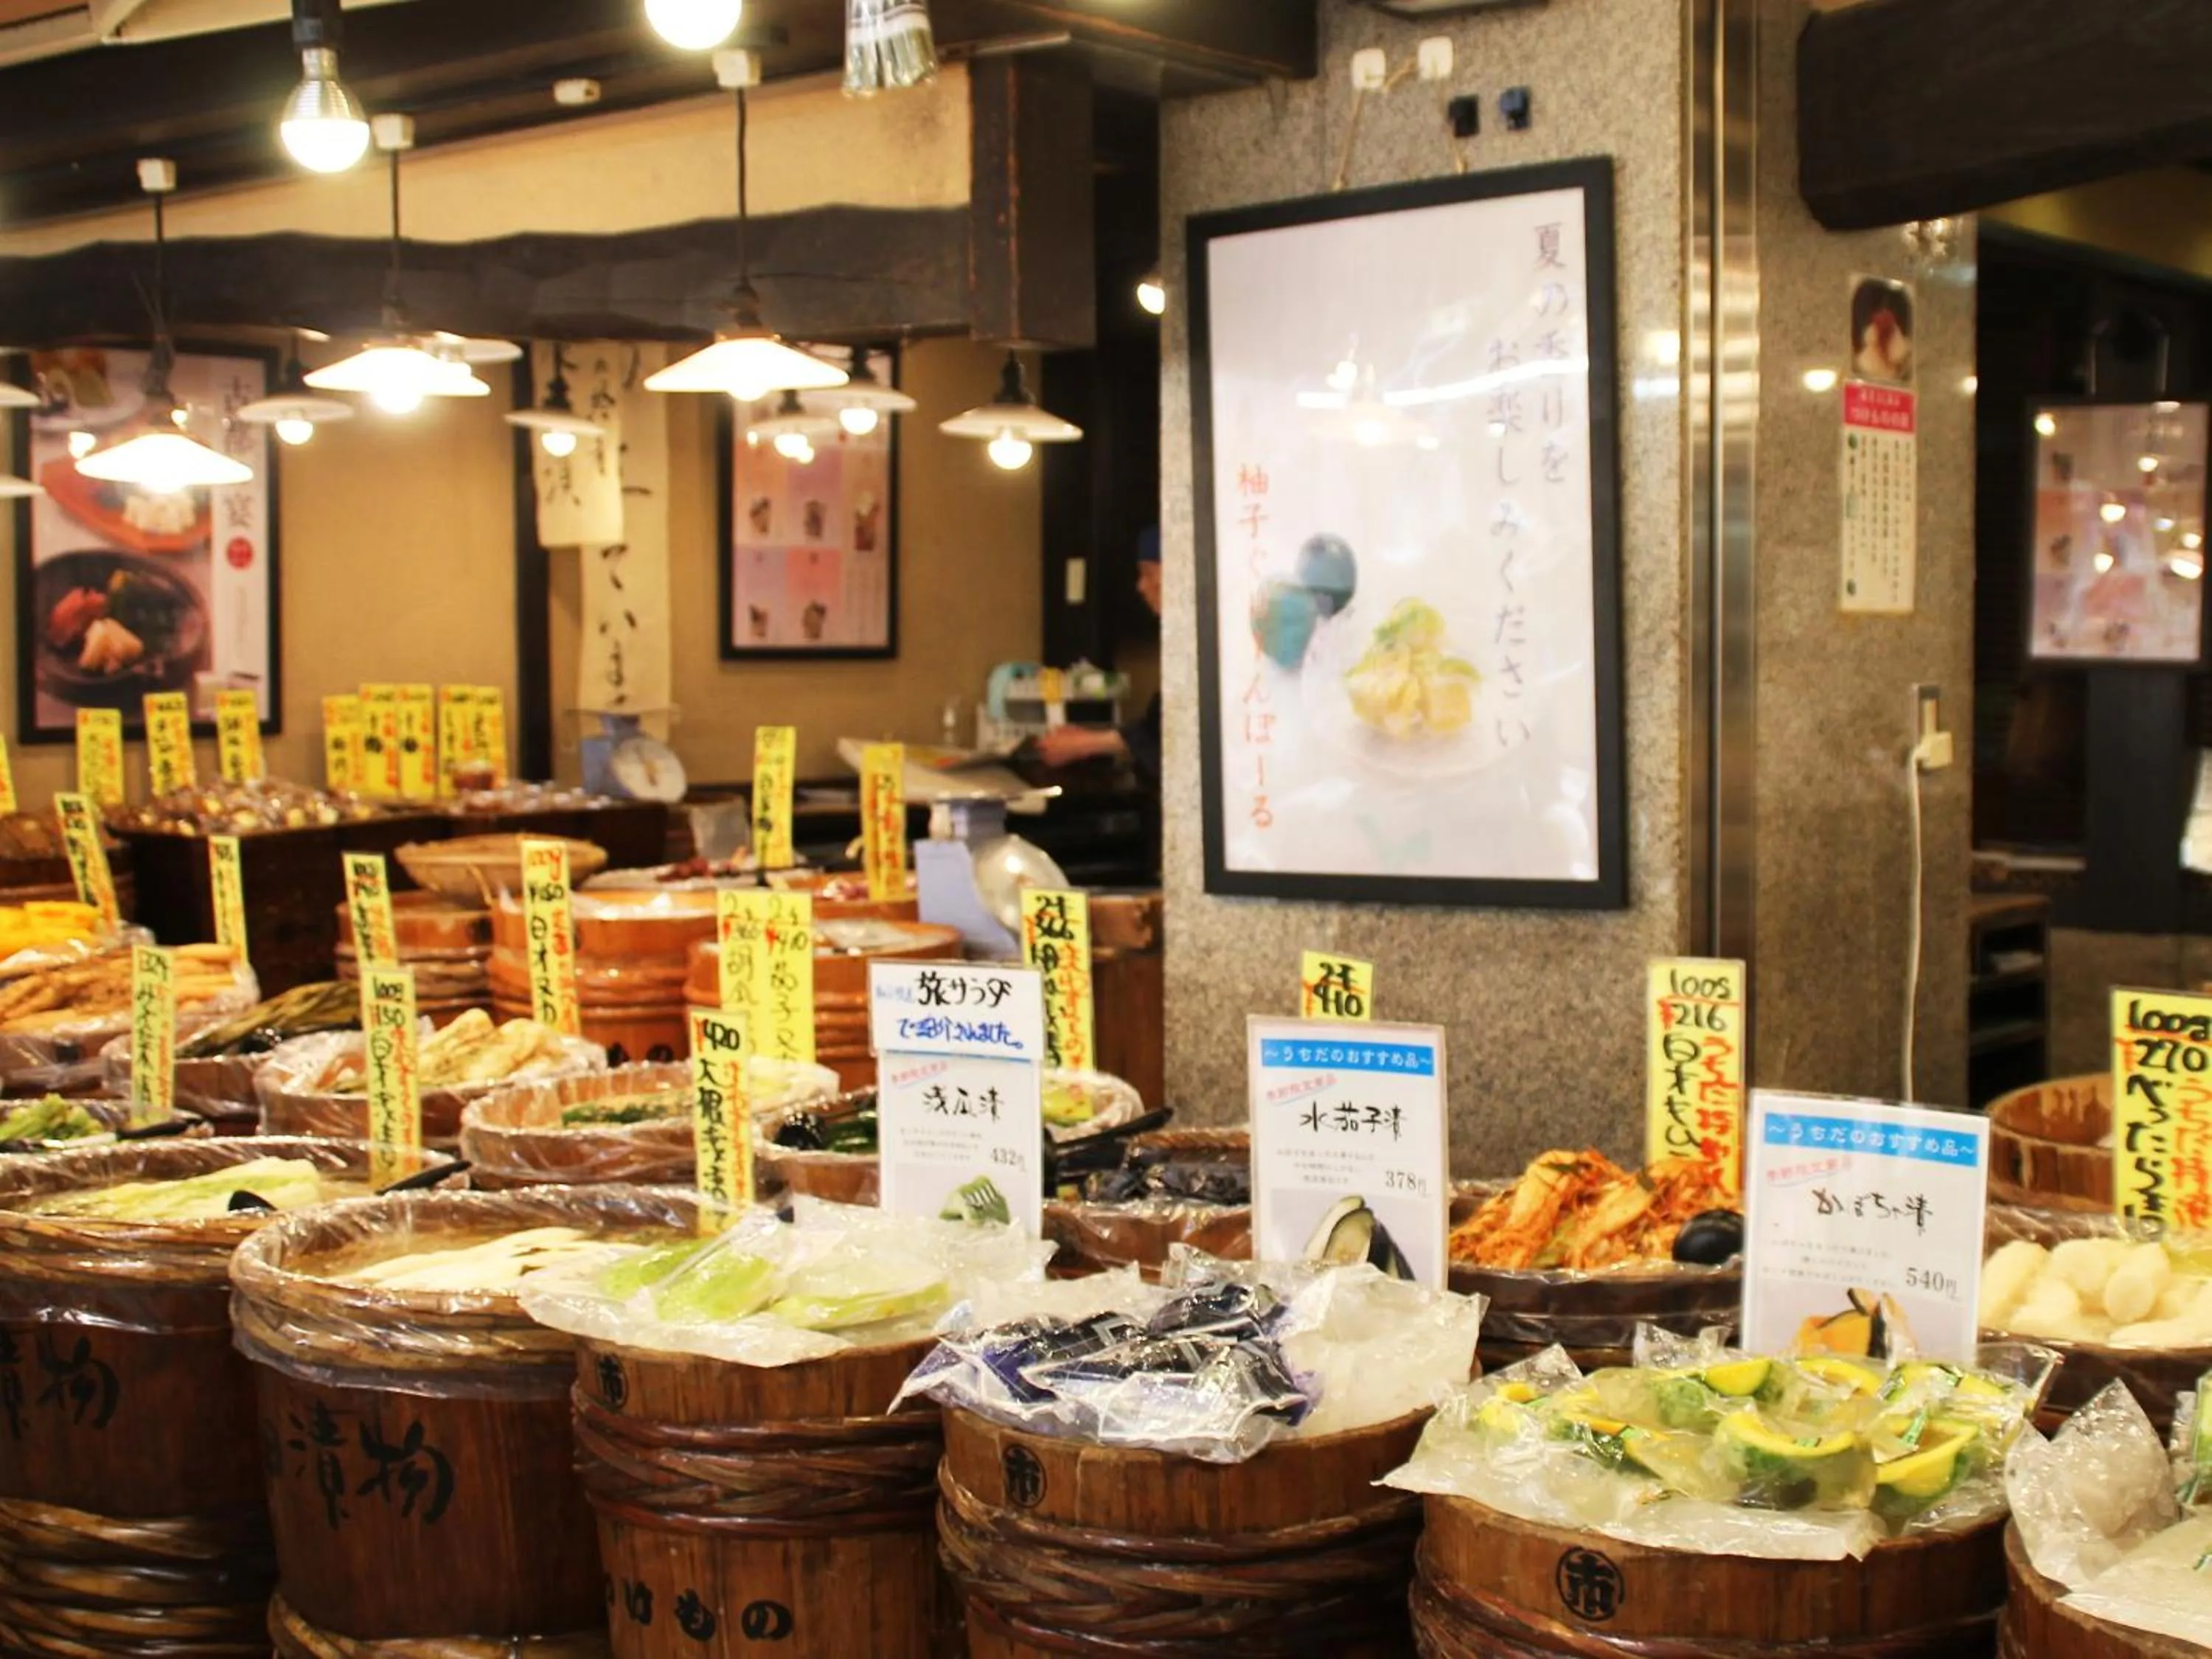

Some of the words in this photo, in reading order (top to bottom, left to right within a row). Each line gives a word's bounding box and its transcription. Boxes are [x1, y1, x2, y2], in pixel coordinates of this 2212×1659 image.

[1487, 339, 1531, 748] お楽しみください
[915, 970, 1012, 1007] 旅サラダ
[1299, 1100, 1408, 1142] 水茄子漬
[1905, 1267, 1960, 1301] 540円
